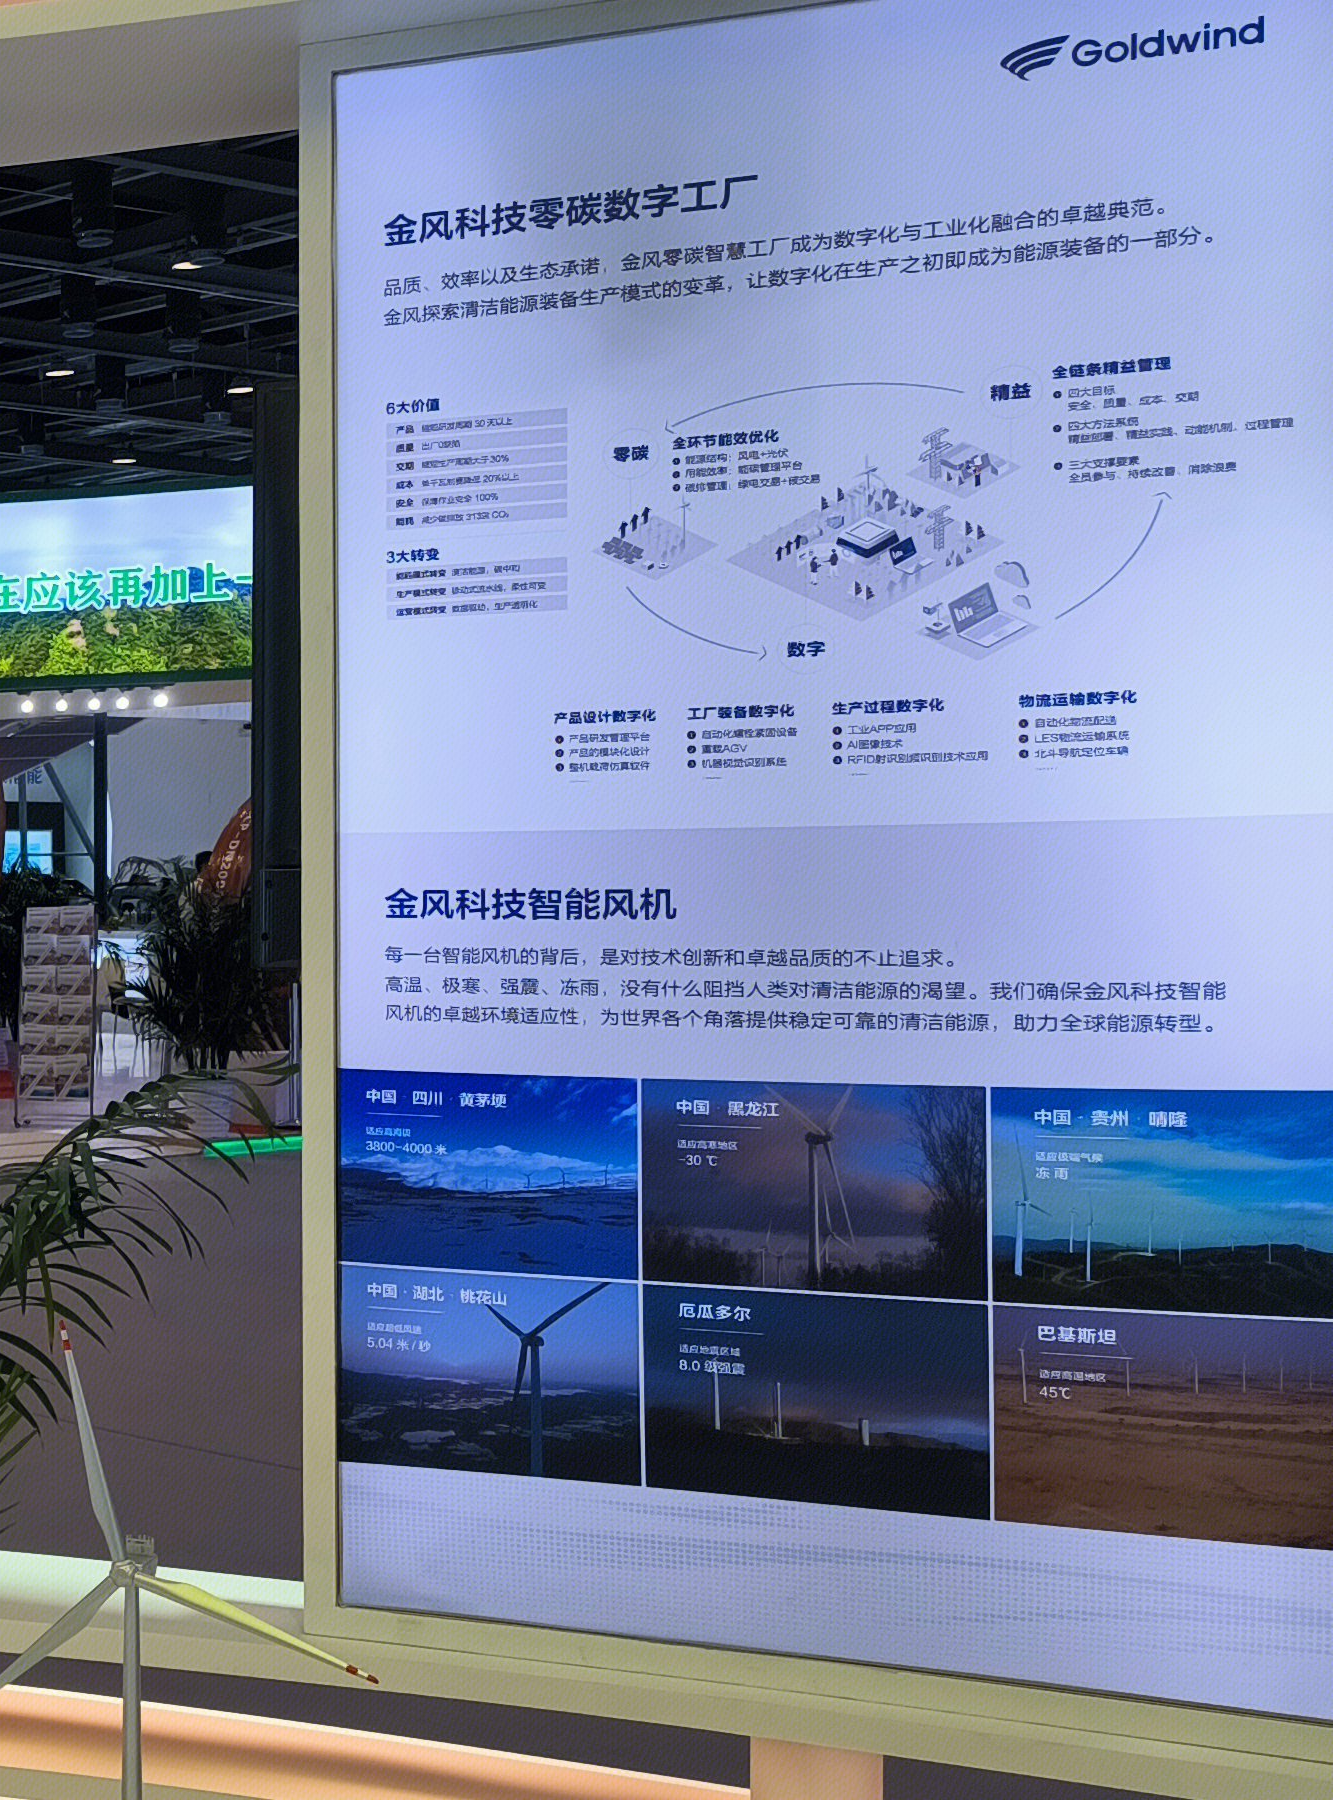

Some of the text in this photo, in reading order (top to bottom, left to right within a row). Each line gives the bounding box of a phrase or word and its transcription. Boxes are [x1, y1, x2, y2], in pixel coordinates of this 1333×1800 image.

[1071, 15, 1265, 67] Goldwind
[384, 174, 759, 247] 金风科技零碳数字工厂
[990, 382, 1032, 401] 精益
[386, 398, 440, 415] 6大价值
[613, 445, 650, 462] 零碳
[386, 548, 440, 564] 3大转变
[787, 640, 826, 658] 数字
[687, 704, 795, 721] 工厂装备数字化
[832, 697, 945, 716] 生产过程数字化
[554, 708, 657, 725] 产品设计数字化
[385, 887, 677, 921] 金风科技智能风机
[366, 1089, 396, 1104] 中国
[676, 1099, 779, 1117] 中国 黑龙江
[1034, 1109, 1071, 1126] 中国
[1091, 1109, 1128, 1126] 贵州
[367, 1282, 507, 1306] 中国 湖北 桃花山
[679, 1303, 751, 1322] 厄瓜多尔
[1037, 1325, 1117, 1345] 巴基斯坦
